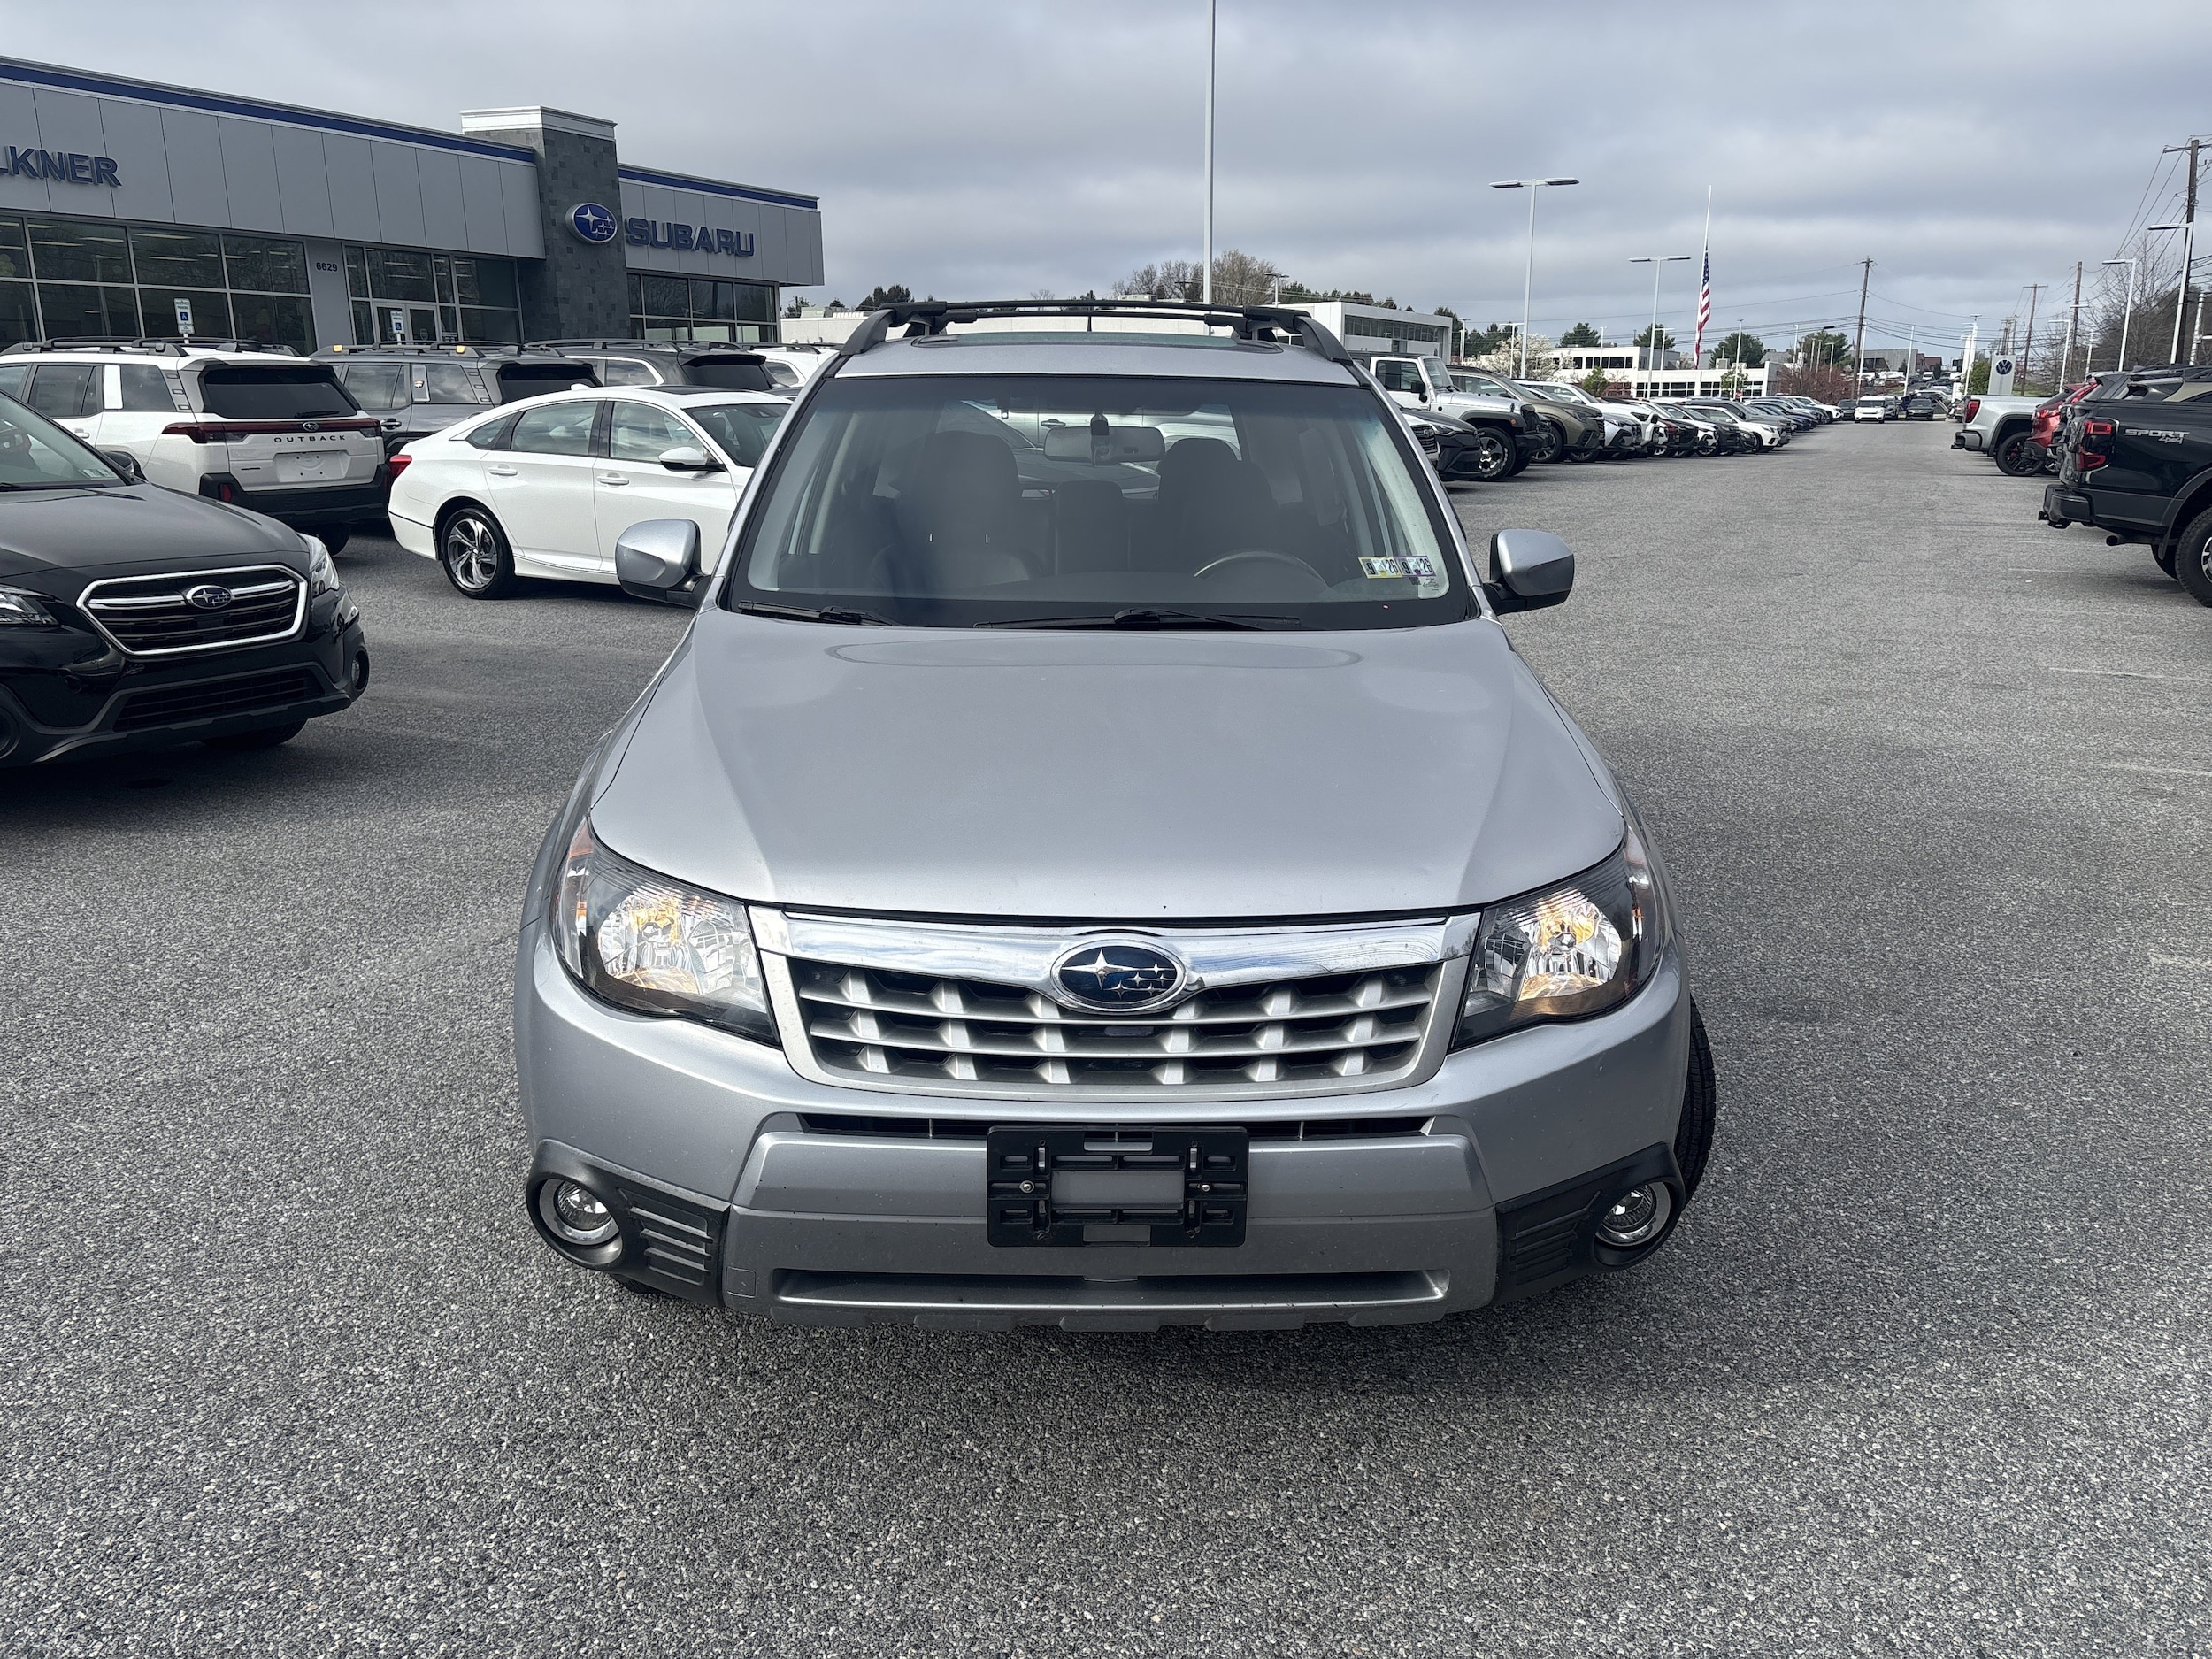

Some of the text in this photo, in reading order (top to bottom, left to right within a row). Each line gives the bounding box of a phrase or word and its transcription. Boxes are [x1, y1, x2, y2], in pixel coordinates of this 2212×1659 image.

[625, 217, 755, 257] SUBARU
[316, 262, 338, 272] 6629
[273, 434, 346, 443] OUTBACK
[2124, 428, 2191, 438] SPORT
[1366, 559, 1399, 575] 9 26
[1402, 558, 1433, 574] 9 26
